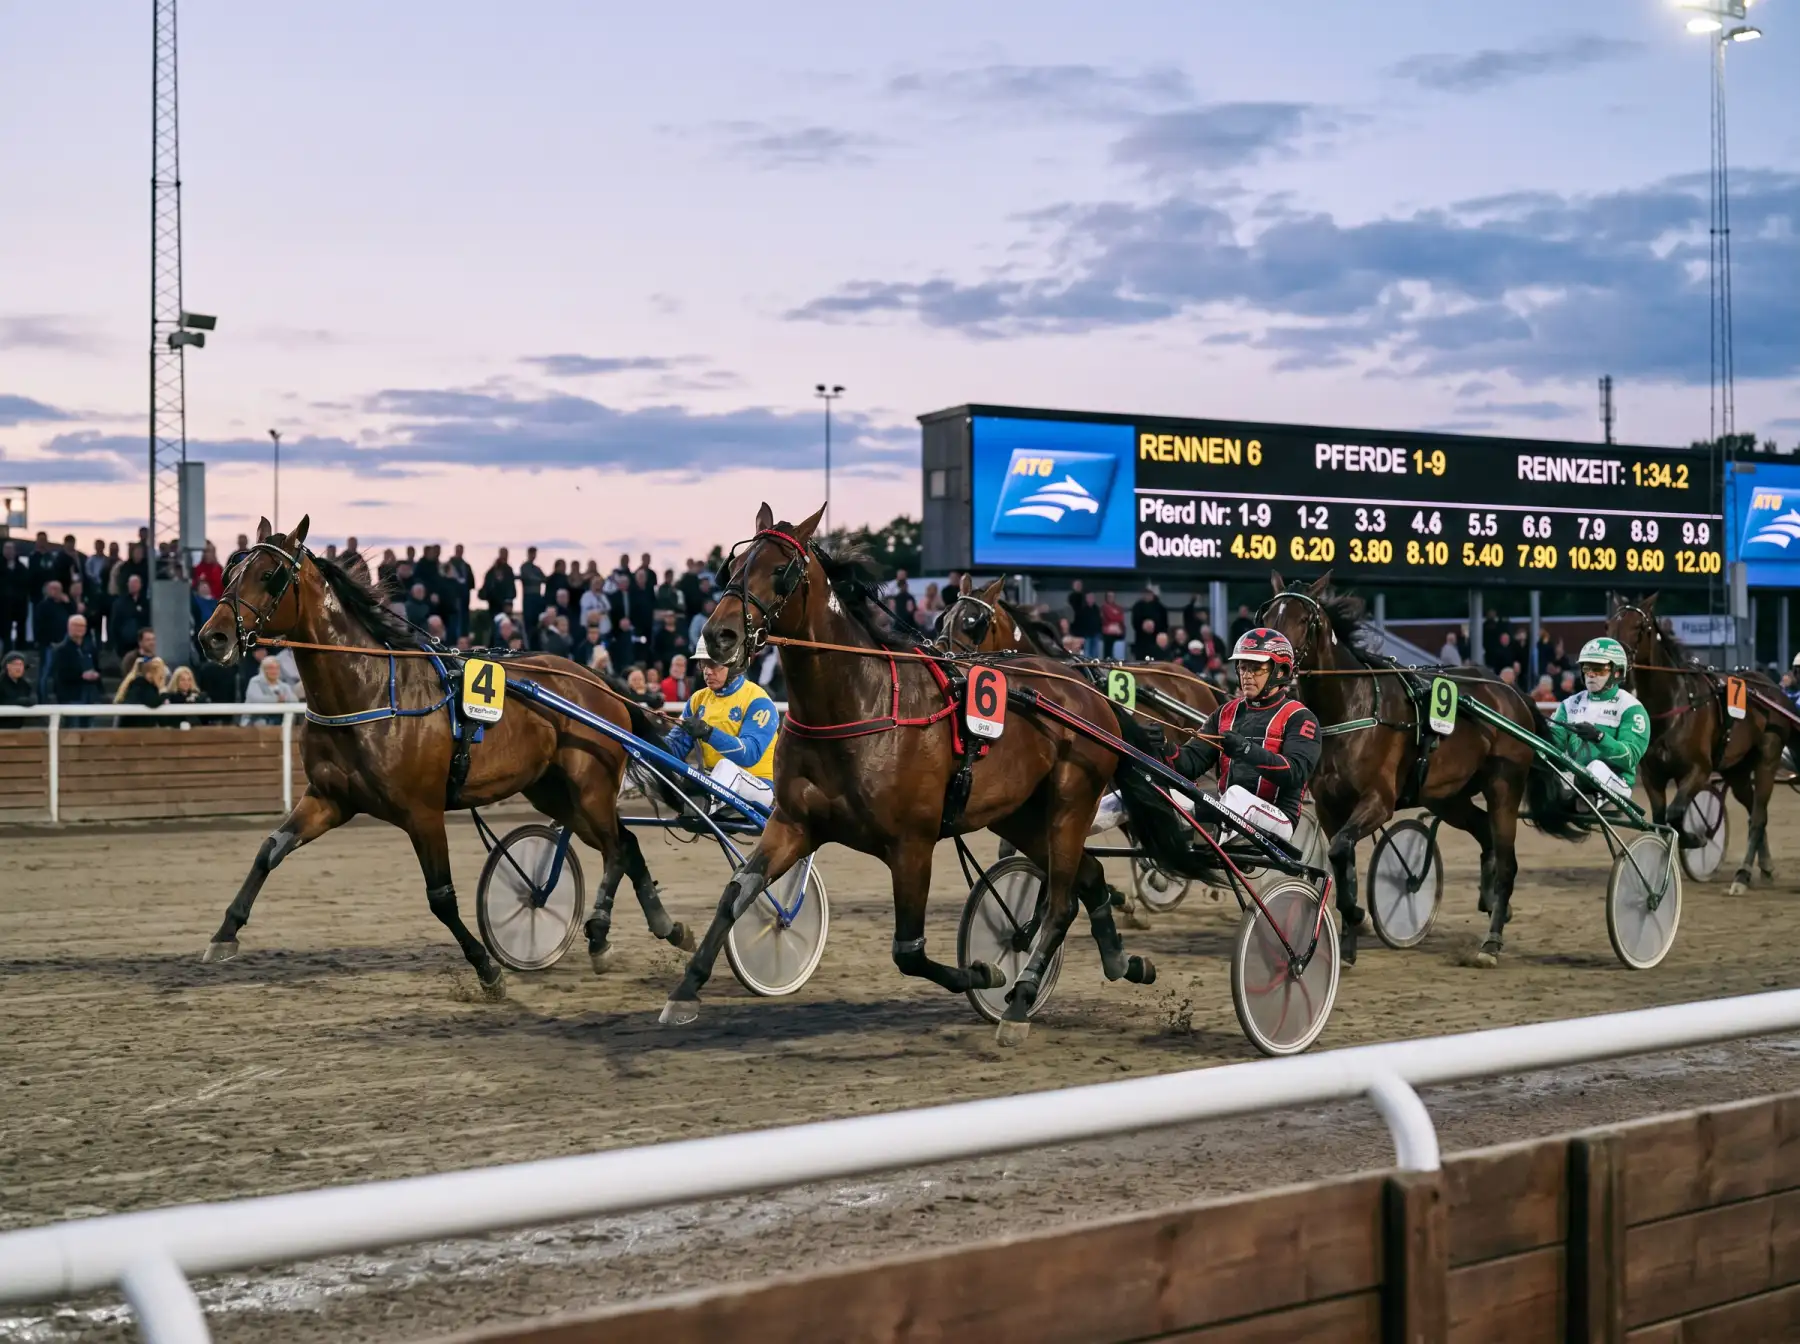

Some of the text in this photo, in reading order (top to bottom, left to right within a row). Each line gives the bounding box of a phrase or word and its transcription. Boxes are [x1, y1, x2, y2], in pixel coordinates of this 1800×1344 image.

[1140, 433, 1262, 466] RENNEN 6
[1315, 443, 1446, 476] PFERDE 1-9
[1012, 457, 1055, 477] ATG
[1517, 455, 1689, 489] RENNZEIT: 1:34.2
[1139, 497, 1711, 546] Pferd Nr: 1-9 1-2 3.3 4.6 5.5 6.6 7.9 8.9 9.9
[1139, 530, 1721, 574] Quoten: 4.50 6.20 3.80 8.10 5.40 7.90 10.30 9.60 12.00
[471, 663, 496, 704] 4
[974, 670, 998, 717] 6
[1114, 672, 1130, 704] 3
[1436, 681, 1453, 718] 9
[1731, 678, 1743, 706] 7
